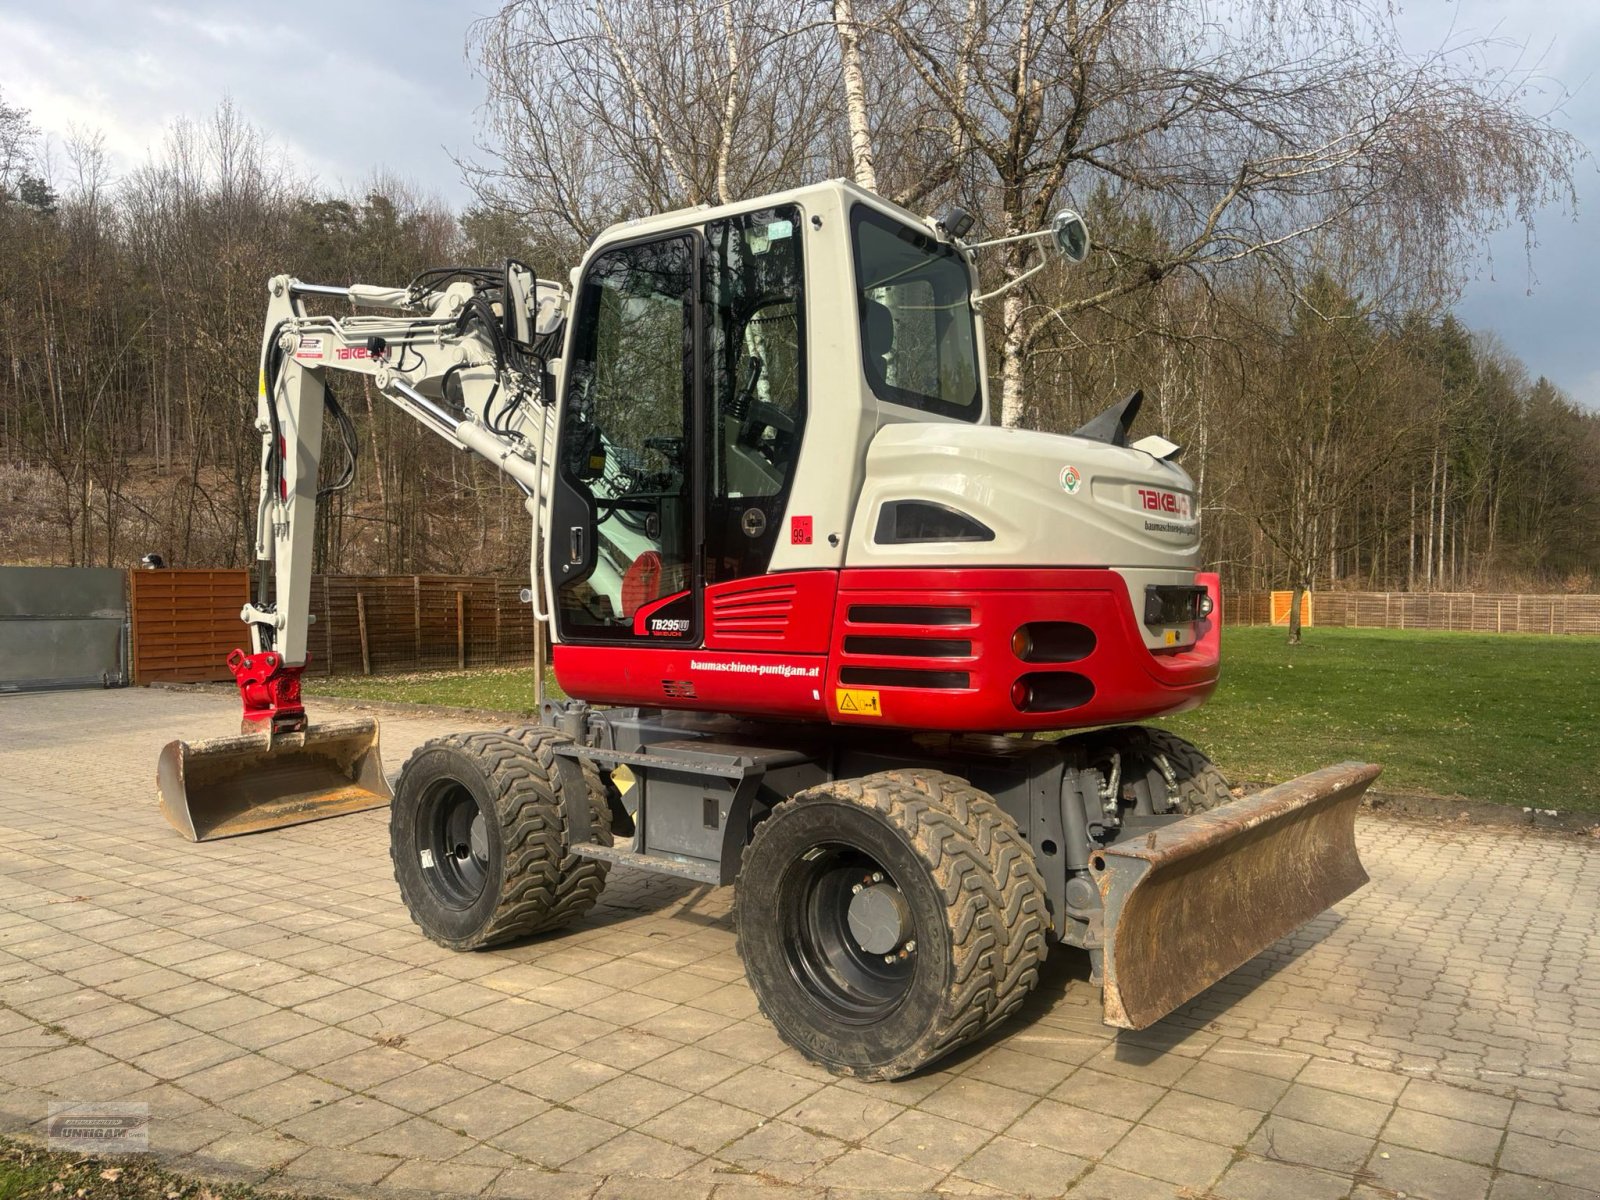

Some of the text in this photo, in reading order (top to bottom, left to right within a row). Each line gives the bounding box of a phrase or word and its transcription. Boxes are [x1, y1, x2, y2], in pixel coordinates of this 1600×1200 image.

[336, 346, 392, 360] TAKEUHI
[1138, 489, 1188, 516] TAKEU
[793, 528, 804, 543] 99
[651, 619, 690, 631] TB295W
[690, 659, 820, 678] baumaschinen-puntigam.at
